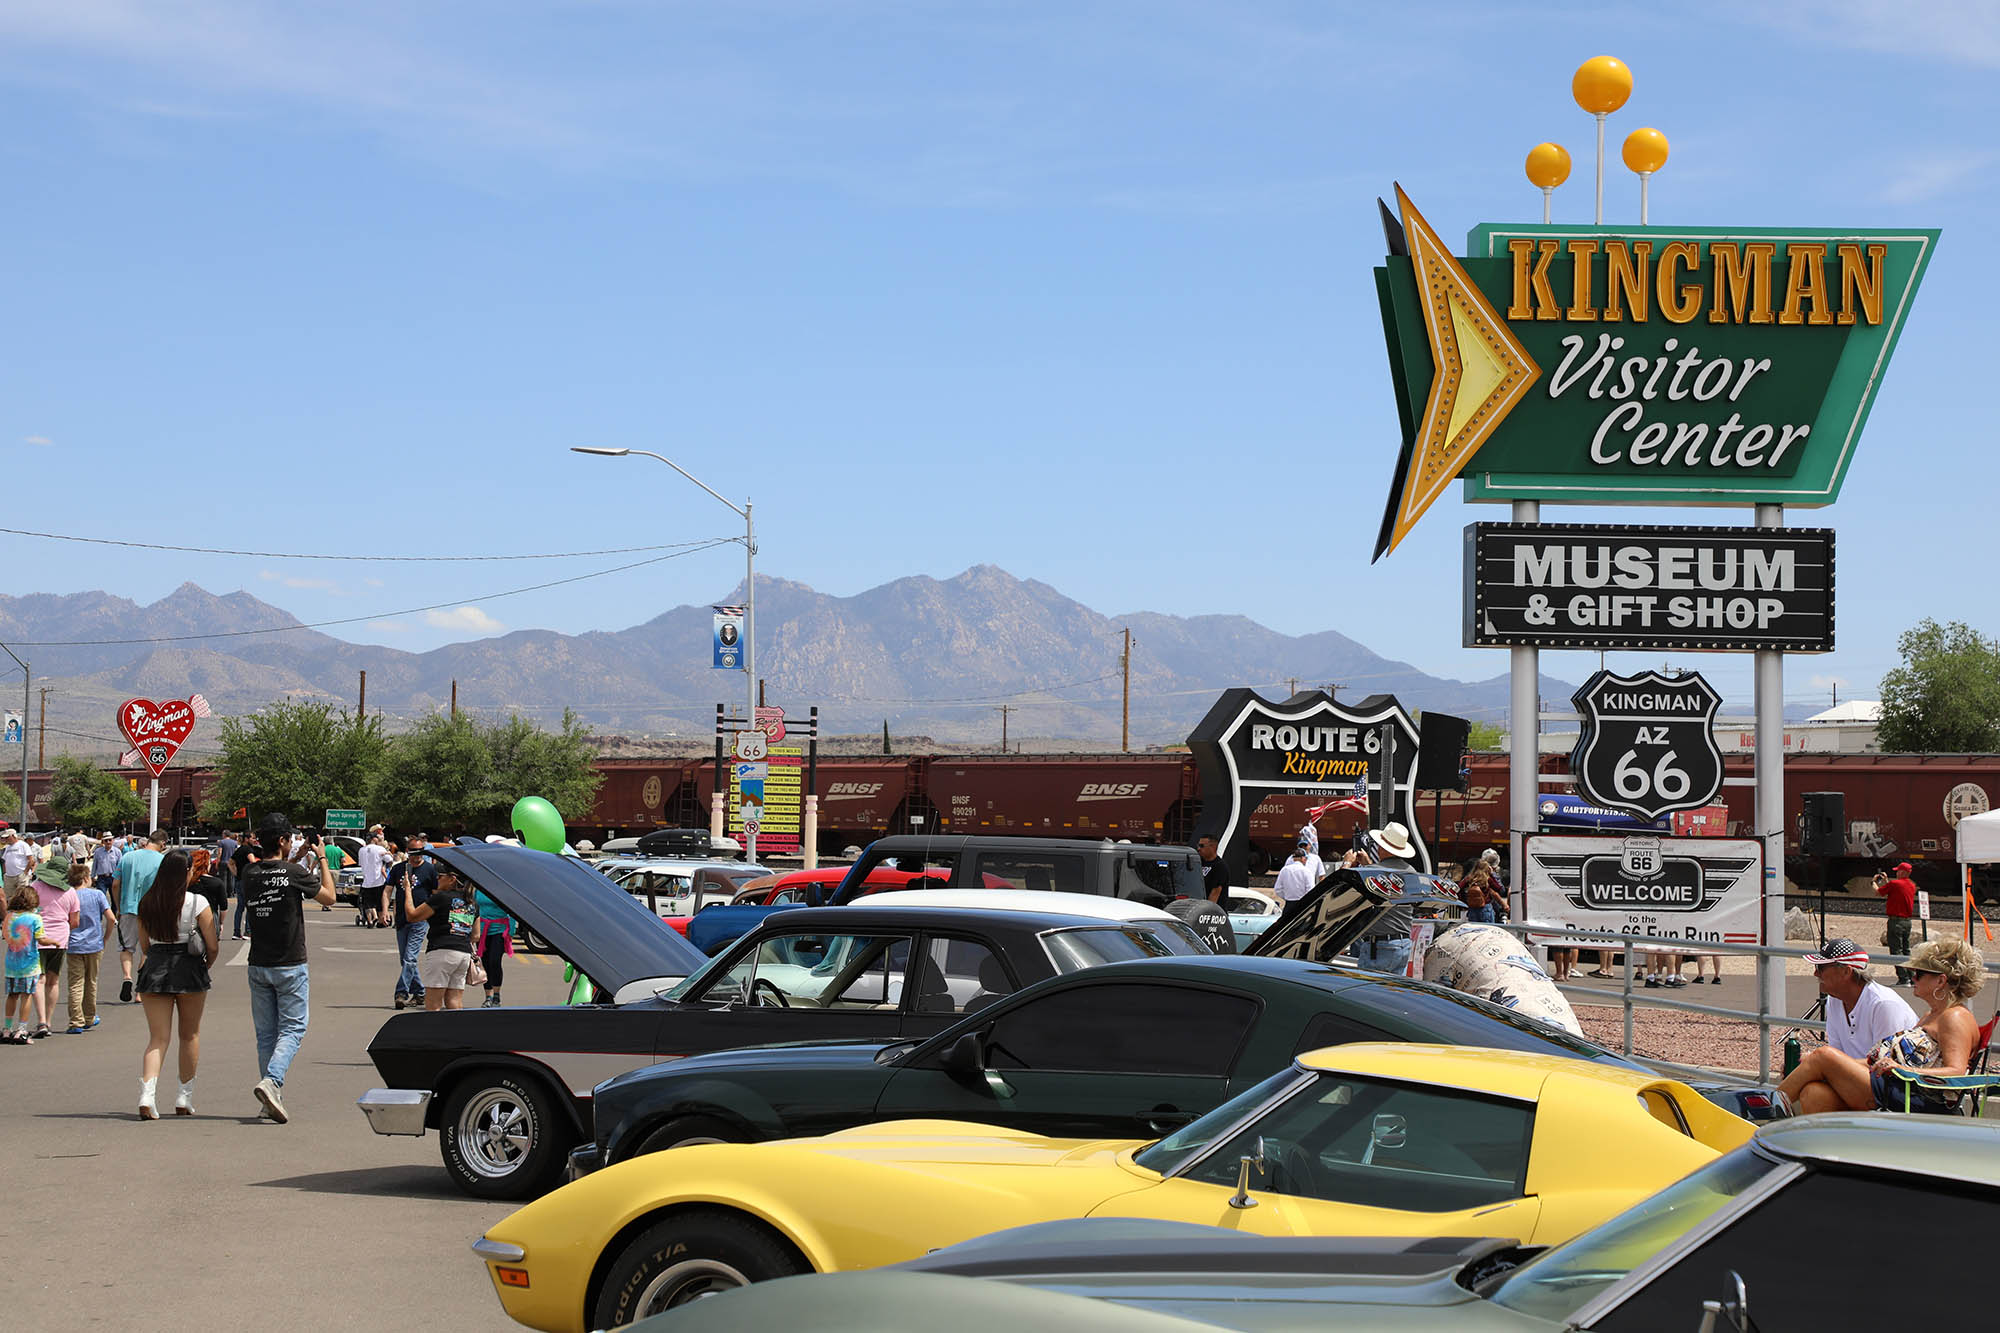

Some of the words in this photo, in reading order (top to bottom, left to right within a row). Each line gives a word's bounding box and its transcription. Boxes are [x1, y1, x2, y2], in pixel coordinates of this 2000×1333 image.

[1506, 239, 1887, 325] KINGMAN
[1548, 333, 1772, 401] Visitor
[1590, 402, 1810, 468] Center
[1513, 544, 1796, 592] MUSEUM
[1523, 594, 1556, 626] &
[1567, 595, 1657, 627] GIFT
[1668, 597, 1785, 629] SHOP
[1603, 693, 1701, 711] KINGMAN
[135, 706, 190, 738] Kingman
[137, 737, 153, 747] HEART
[160, 737, 180, 747] HISTORIC
[1252, 724, 1358, 753] ROUTE
[1634, 726, 1670, 745] AZ
[151, 753, 165, 763] 66
[743, 745, 761, 757] 66
[1283, 751, 1369, 782] Kingman
[1613, 749, 1691, 800] 66
[143, 787, 170, 795] BSF
[828, 782, 884, 794] BNSF
[1080, 783, 1149, 797] BNSF
[952, 795, 970, 804] BNSF
[952, 807, 976, 816] 490291
[1629, 850, 1654, 858] ROUTE
[1631, 857, 1652, 870] 66
[1592, 884, 1693, 902] WELCOME
[1198, 914, 1211, 925] OFF
[1211, 915, 1227, 925] ROAD
[1629, 915, 1638, 924] to
[1641, 915, 1657, 924] the
[1647, 925, 1679, 940] Fun
[1685, 926, 1720, 943] Run
[449, 1148, 479, 1183] Radial
[652, 1242, 688, 1263] T/A
[615, 1263, 649, 1325] adial
